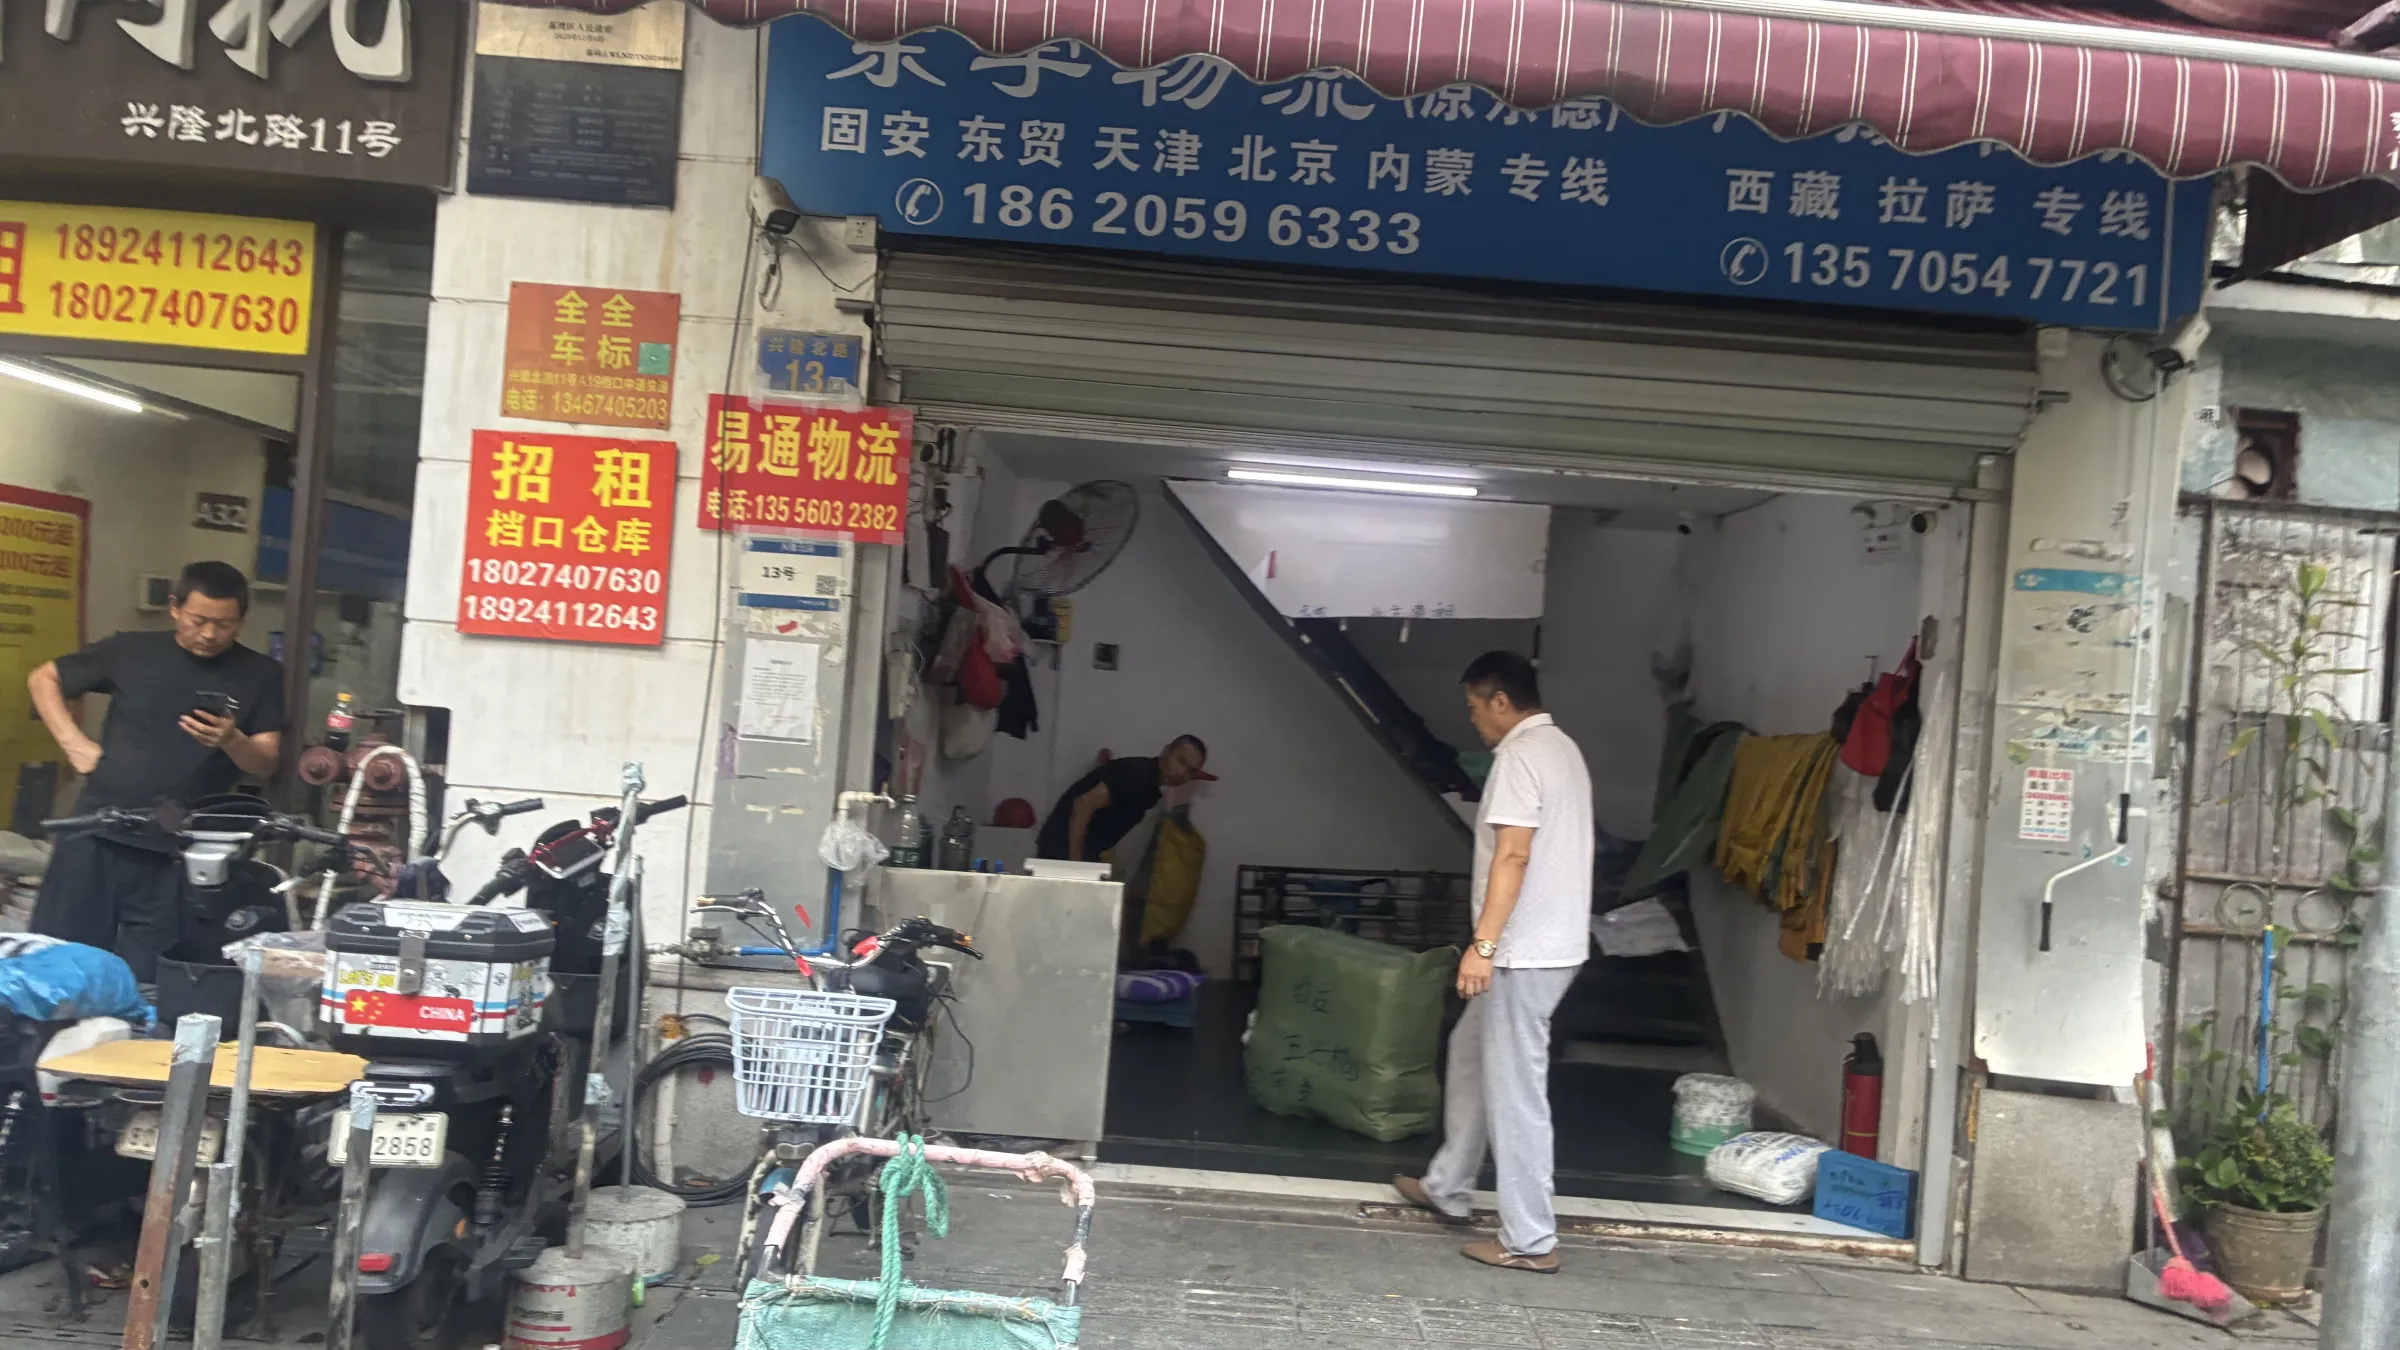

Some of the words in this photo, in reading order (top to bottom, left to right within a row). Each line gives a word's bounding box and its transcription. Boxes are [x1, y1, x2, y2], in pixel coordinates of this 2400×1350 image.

[121, 102, 401, 158] 兴隆北路11号
[821, 106, 930, 159] 固安
[957, 115, 1066, 168] 东贸
[1093, 126, 1203, 177] 天津
[1228, 134, 1339, 185] 北京
[1367, 144, 1475, 196] 内蒙
[1500, 153, 1610, 207] 专线
[962, 183, 1073, 230] 186
[1092, 191, 1248, 242] 2059
[1267, 204, 1421, 255] 6333
[1725, 168, 1840, 220] 西藏
[1878, 176, 1996, 229] 拉萨
[2032, 185, 2151, 240] 专线
[56, 222, 305, 277] 18924112643
[1783, 242, 1871, 288] 135
[1888, 249, 2011, 299] 7054
[2026, 257, 2148, 306] 7721
[49, 281, 299, 335] 18027407630
[785, 359, 824, 393] 13
[552, 391, 668, 421] 13467405203
[710, 410, 899, 485] 易通物流
[491, 441, 652, 509] 招租
[485, 509, 652, 557] 档口仓库
[795, 497, 844, 527] 5603
[849, 501, 897, 531] 2382
[467, 557, 661, 594] 18027407630
[463, 596, 657, 632] 18924112643
[420, 1005, 466, 1022] CHINA
